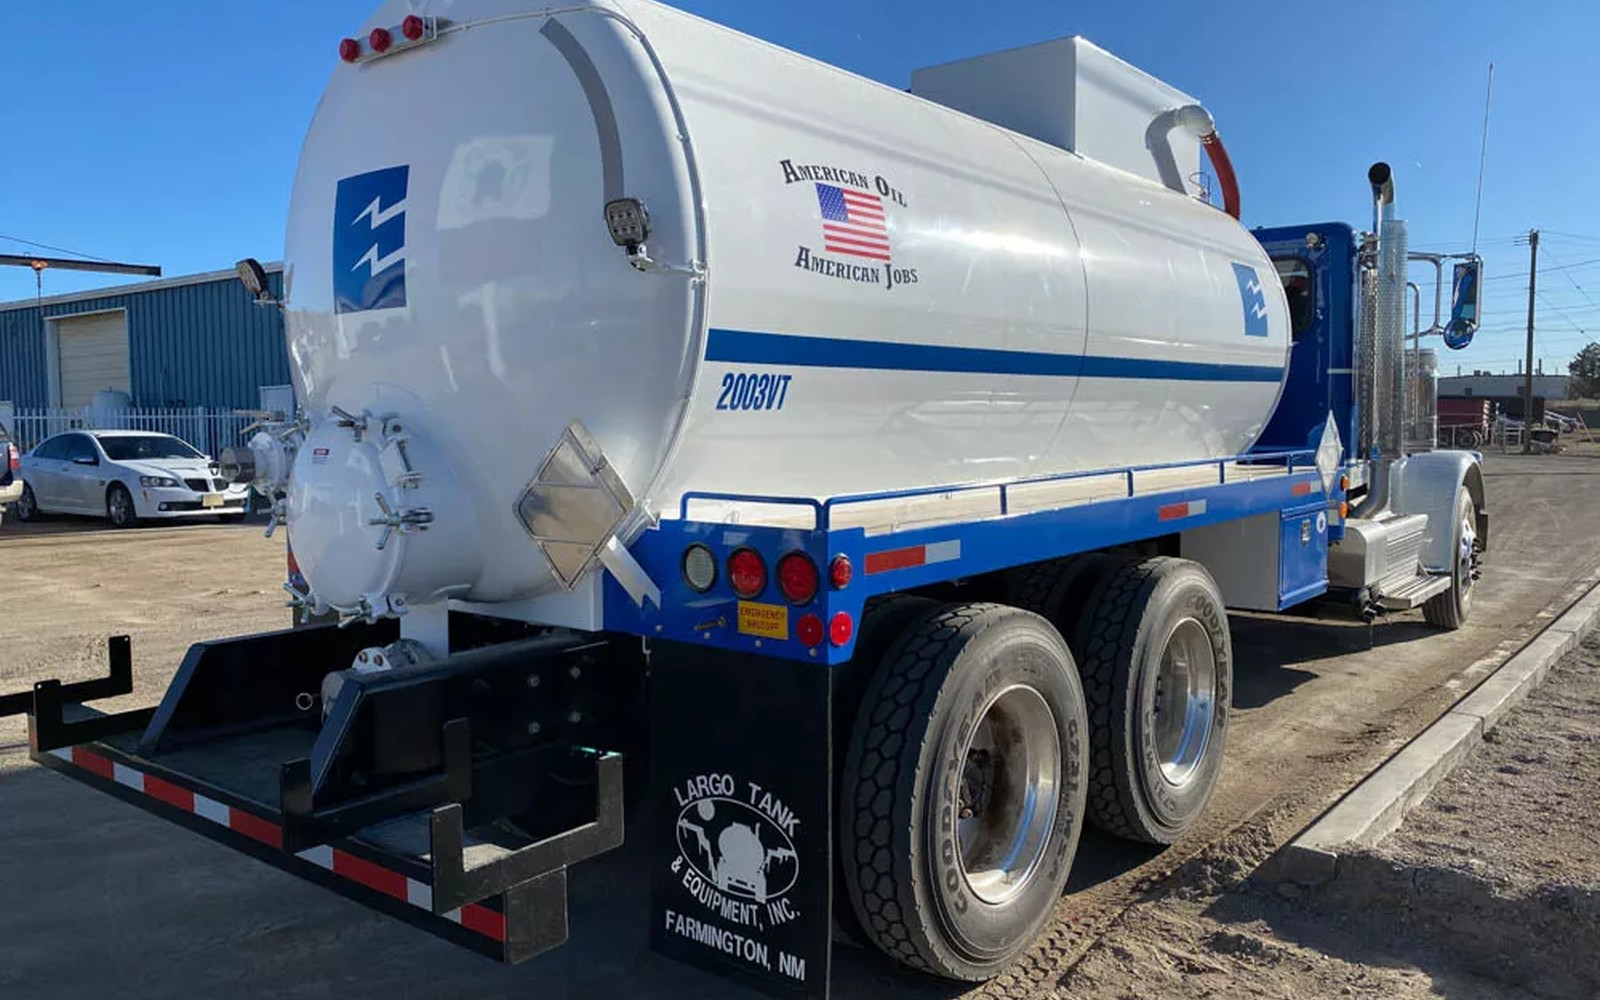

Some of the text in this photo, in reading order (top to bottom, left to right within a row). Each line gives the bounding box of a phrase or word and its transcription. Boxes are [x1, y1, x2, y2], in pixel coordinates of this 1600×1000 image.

[716, 373, 792, 410] 2003VT
[674, 773, 801, 837] LARGO TANK
[671, 855, 801, 932] & EQUIPMENT, INC.
[665, 910, 806, 981] FARMINGTON, NM
